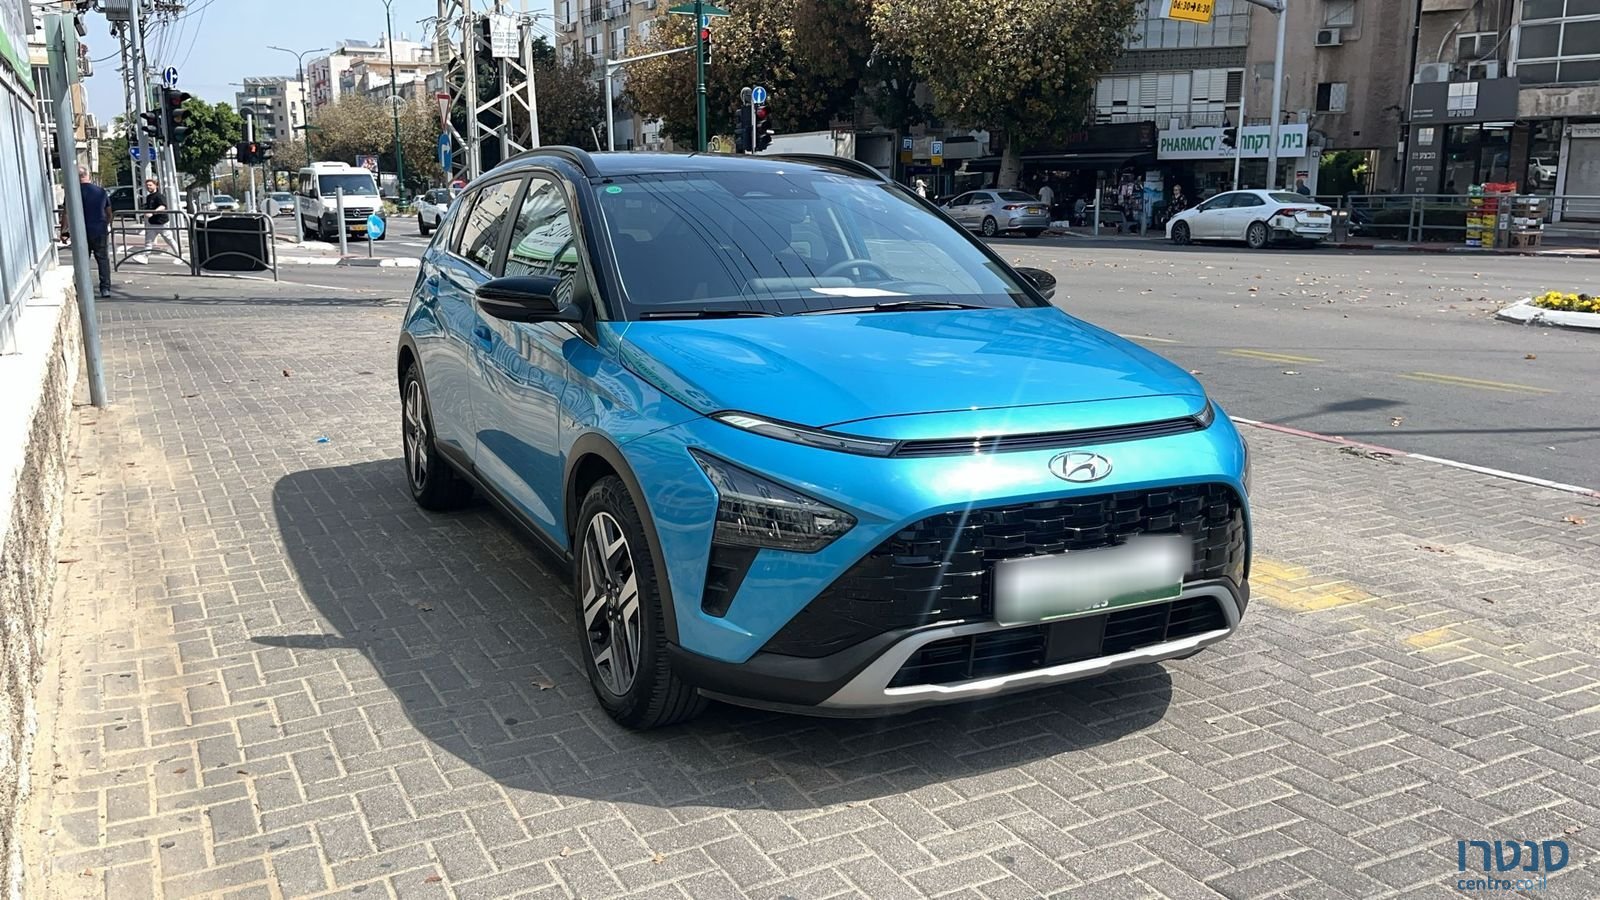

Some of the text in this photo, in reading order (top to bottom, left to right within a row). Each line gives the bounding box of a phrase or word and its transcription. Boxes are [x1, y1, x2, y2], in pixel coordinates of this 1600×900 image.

[1160, 136, 1217, 152] PHARMACY
[1241, 133, 1304, 153] בית רקחת
